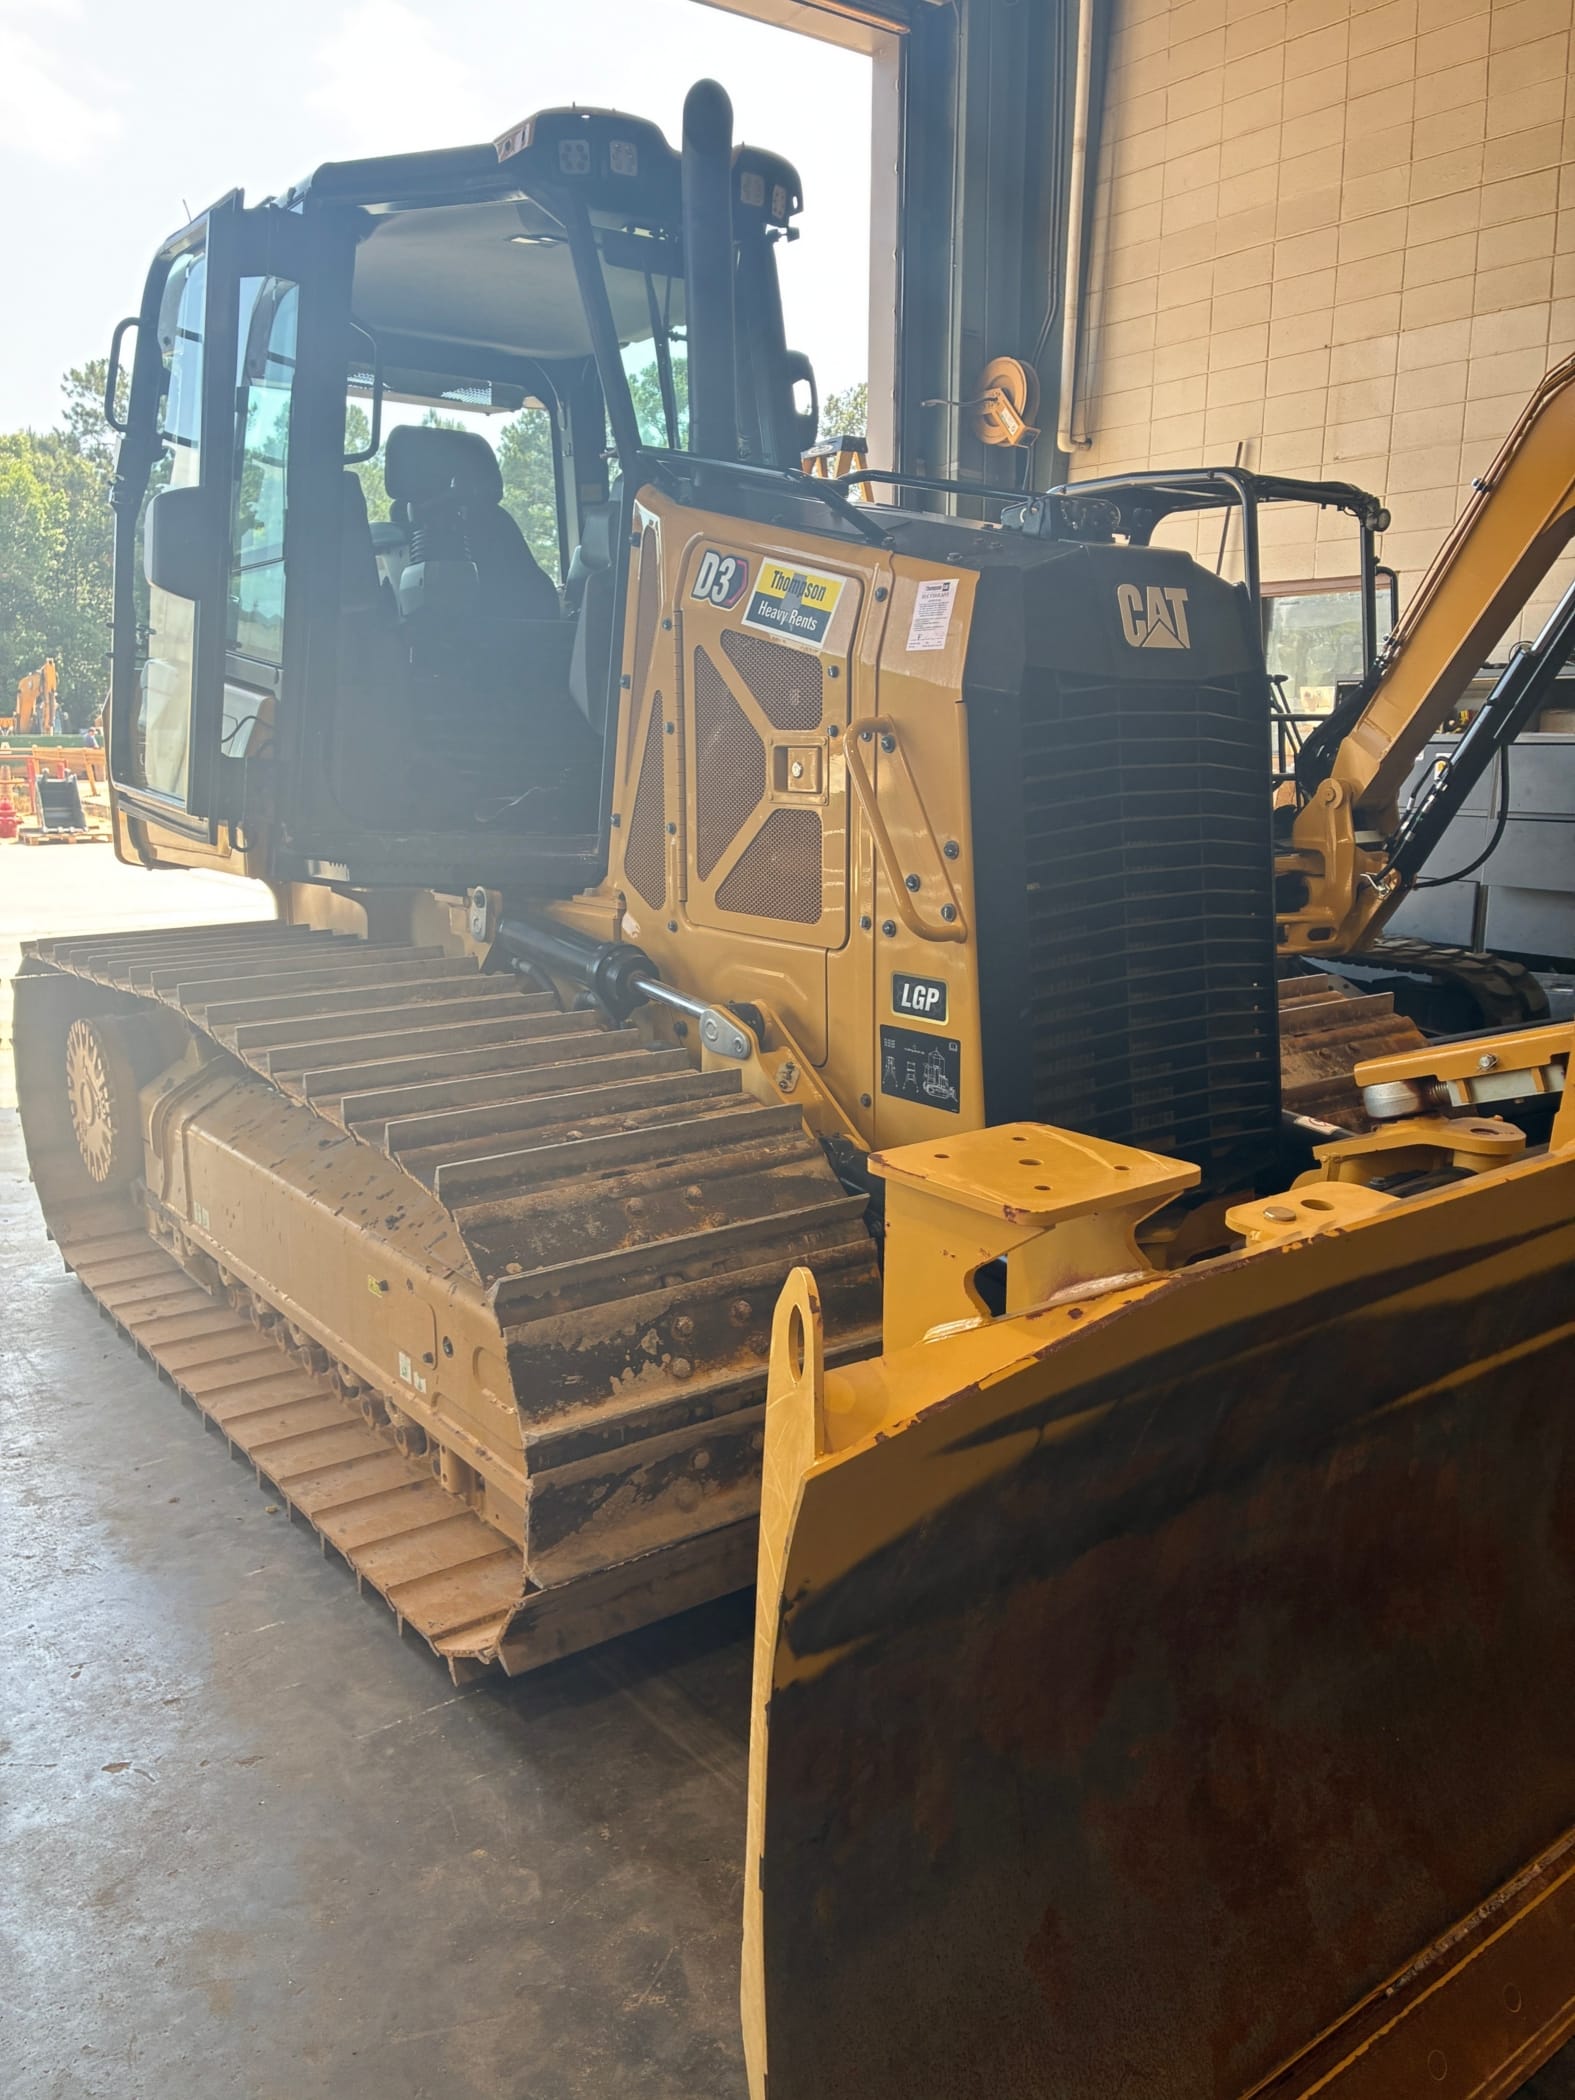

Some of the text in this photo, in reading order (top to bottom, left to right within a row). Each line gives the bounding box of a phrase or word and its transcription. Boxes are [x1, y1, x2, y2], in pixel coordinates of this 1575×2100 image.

[693, 552, 736, 603] D3
[770, 570, 827, 602] Thompson
[758, 600, 818, 631] Heavy Rents
[1117, 583, 1190, 649] CAT
[901, 983, 940, 1012] LGP
